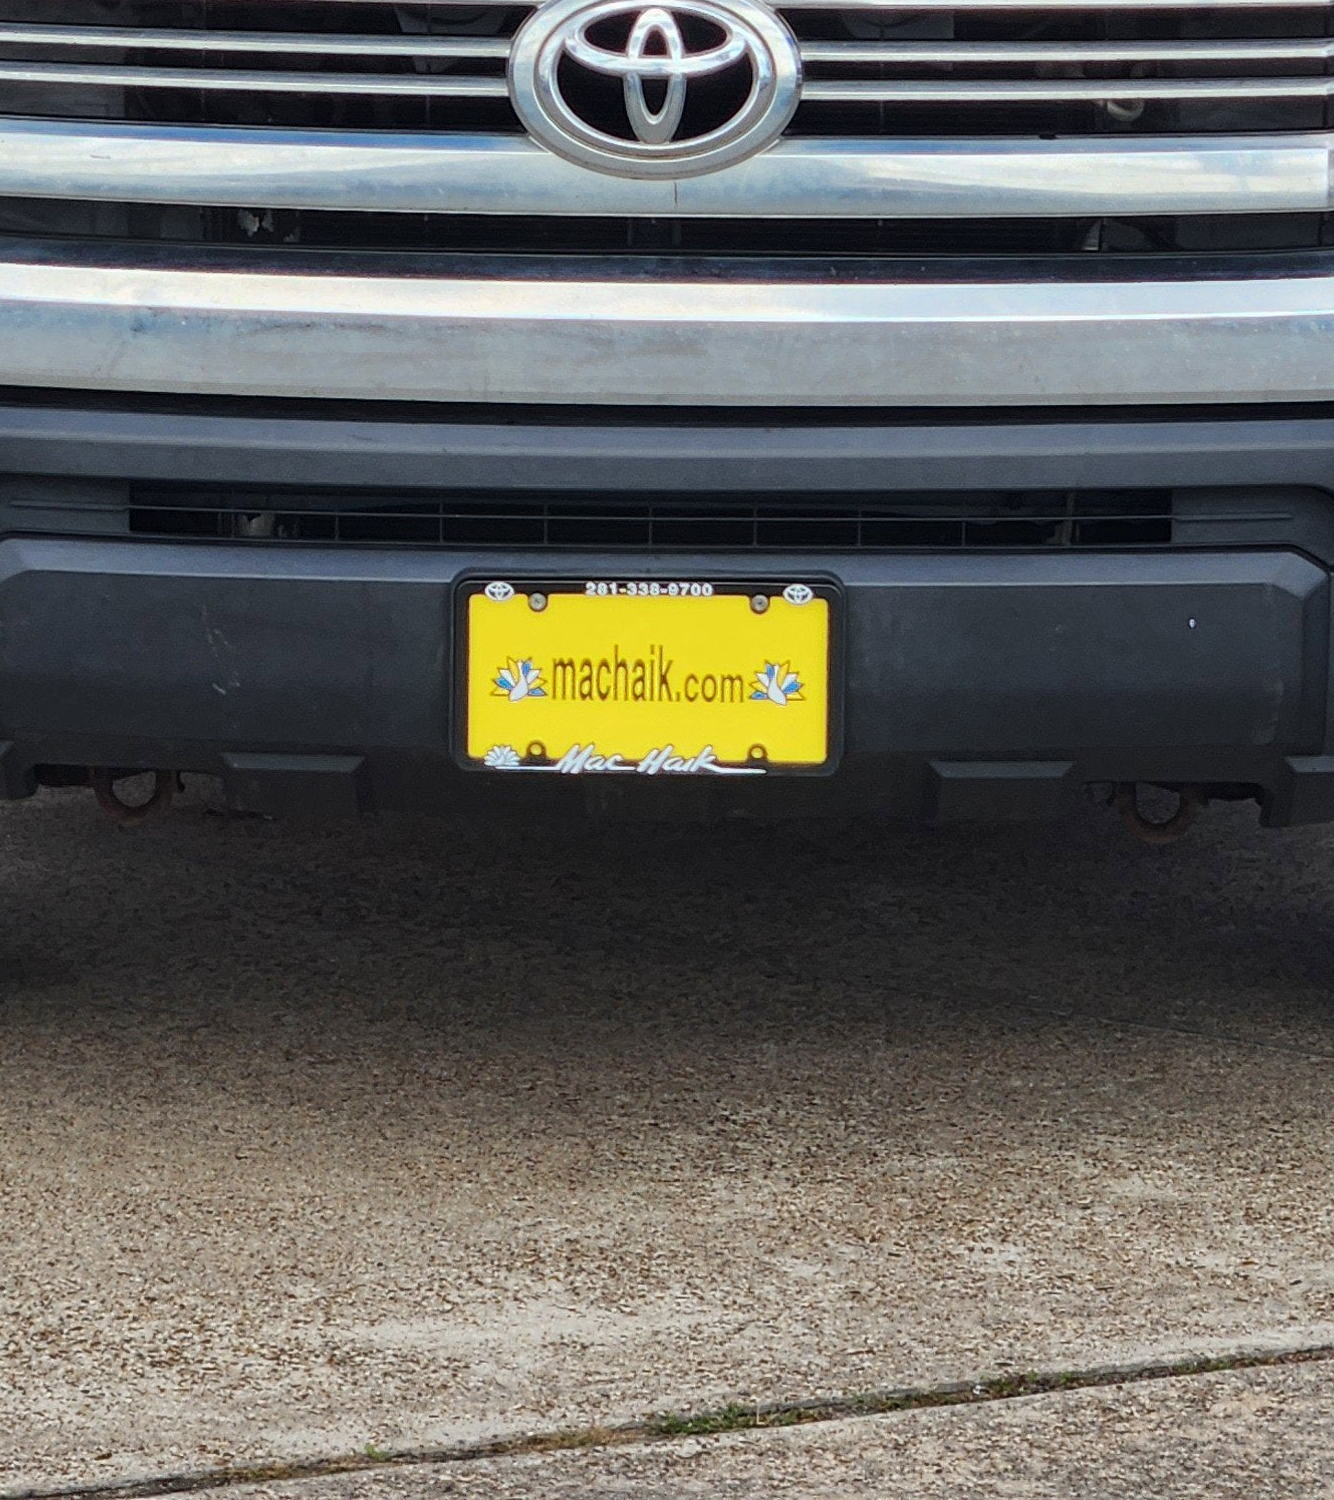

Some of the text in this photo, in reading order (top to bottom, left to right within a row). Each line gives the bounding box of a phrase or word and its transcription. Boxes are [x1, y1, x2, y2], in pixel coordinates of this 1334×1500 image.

[585, 581, 713, 596] 281-338-9700
[551, 644, 744, 703] machaik.com
[556, 743, 717, 775] Mac Haik
